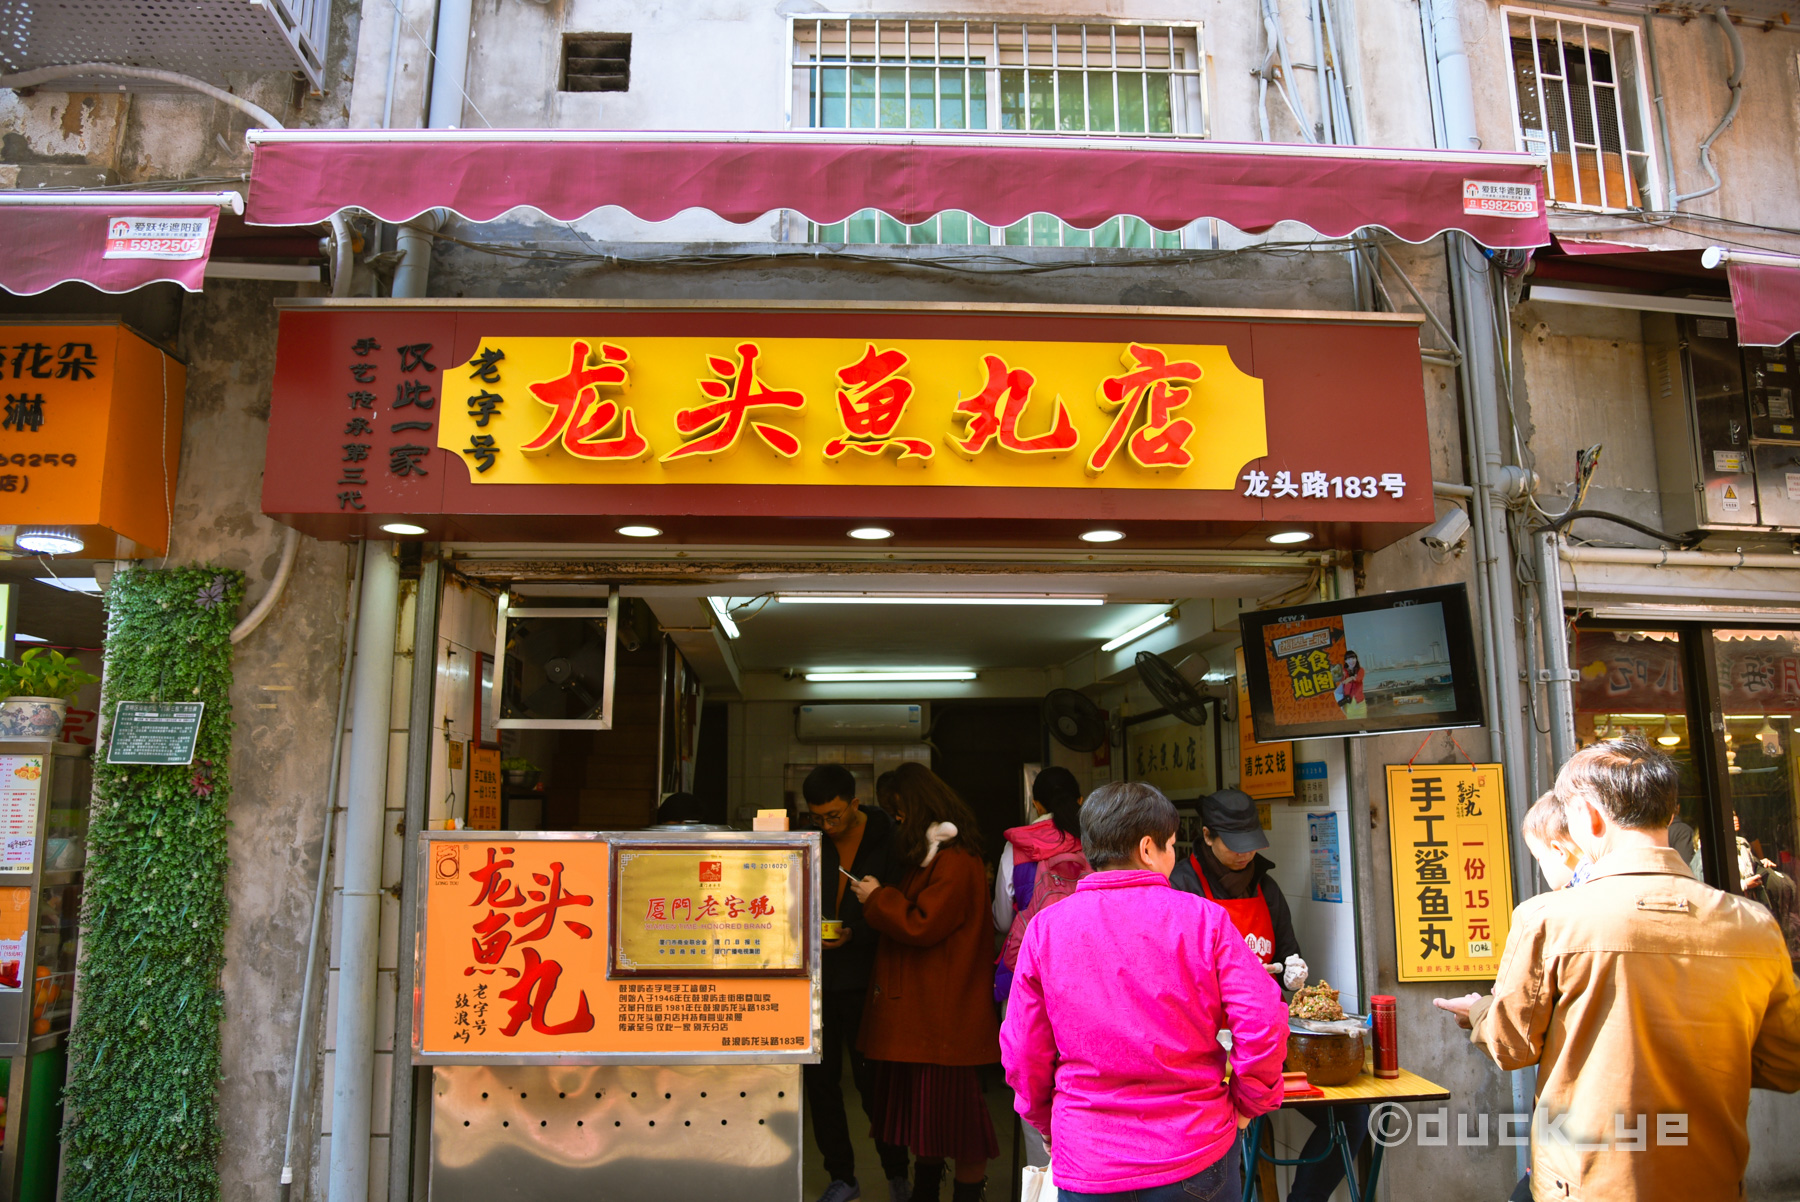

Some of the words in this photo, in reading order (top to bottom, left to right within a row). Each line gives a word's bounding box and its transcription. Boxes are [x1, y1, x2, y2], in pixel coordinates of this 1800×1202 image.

[1481, 200, 1532, 211] 5982509
[135, 222, 203, 232] 爱跃华遮阳篷
[130, 240, 200, 252] 5982509
[2, 393, 46, 432] 淋
[337, 337, 381, 510] 手艺传承第三代
[389, 342, 437, 477] 仅此一家
[463, 346, 506, 473] 老字号
[1241, 470, 1407, 499] 龙头路183号
[1289, 650, 1330, 677] 美食
[1293, 670, 1336, 699] 地图
[1245, 750, 1287, 777] 请先交钱
[1410, 777, 1456, 960] 手工鲨鱼丸
[1462, 841, 1491, 941] 一份15元
[743, 922, 773, 930] BRAND
[453, 993, 471, 1045] 鼓浪屿
[472, 983, 489, 1036] 老字号
[618, 1003, 663, 1012] 改革开放后
[665, 1003, 780, 1012] 1981年在鼓浪屿龙头路183号
[618, 1013, 743, 1022] 成立龙头鱼丸店并持有营业执照
[618, 1023, 654, 1032] 传承至今
[656, 1023, 691, 1032] 仅此一家
[693, 1023, 729, 1032] 别无分店
[721, 1036, 805, 1046] 鼓浪屿龙头路183号
